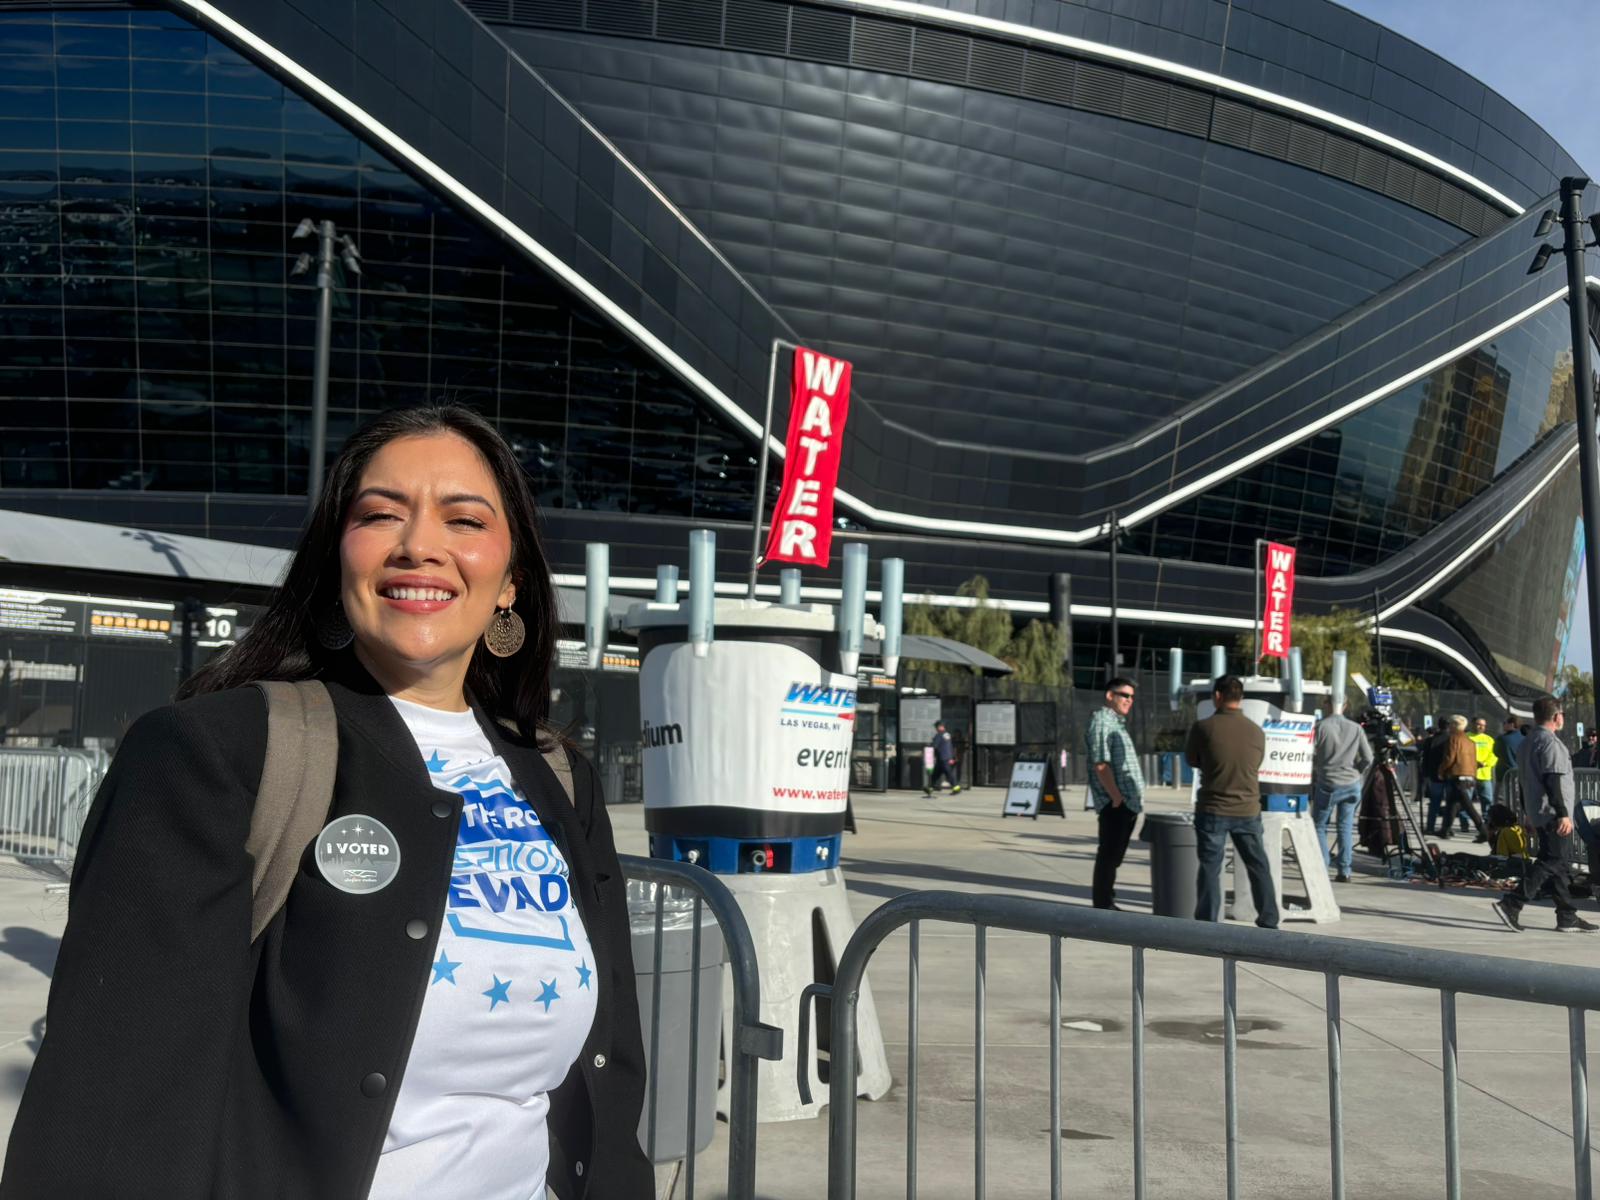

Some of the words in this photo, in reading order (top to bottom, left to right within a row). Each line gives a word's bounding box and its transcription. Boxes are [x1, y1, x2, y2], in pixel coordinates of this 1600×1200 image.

[779, 352, 845, 558] WATER
[1266, 548, 1293, 654] WATER
[205, 618, 231, 638] 10
[780, 718, 799, 727] LAS
[1270, 750, 1305, 762] event
[1012, 780, 1040, 790] MEDIA
[326, 842, 332, 854] I
[336, 842, 390, 856] VOTED
